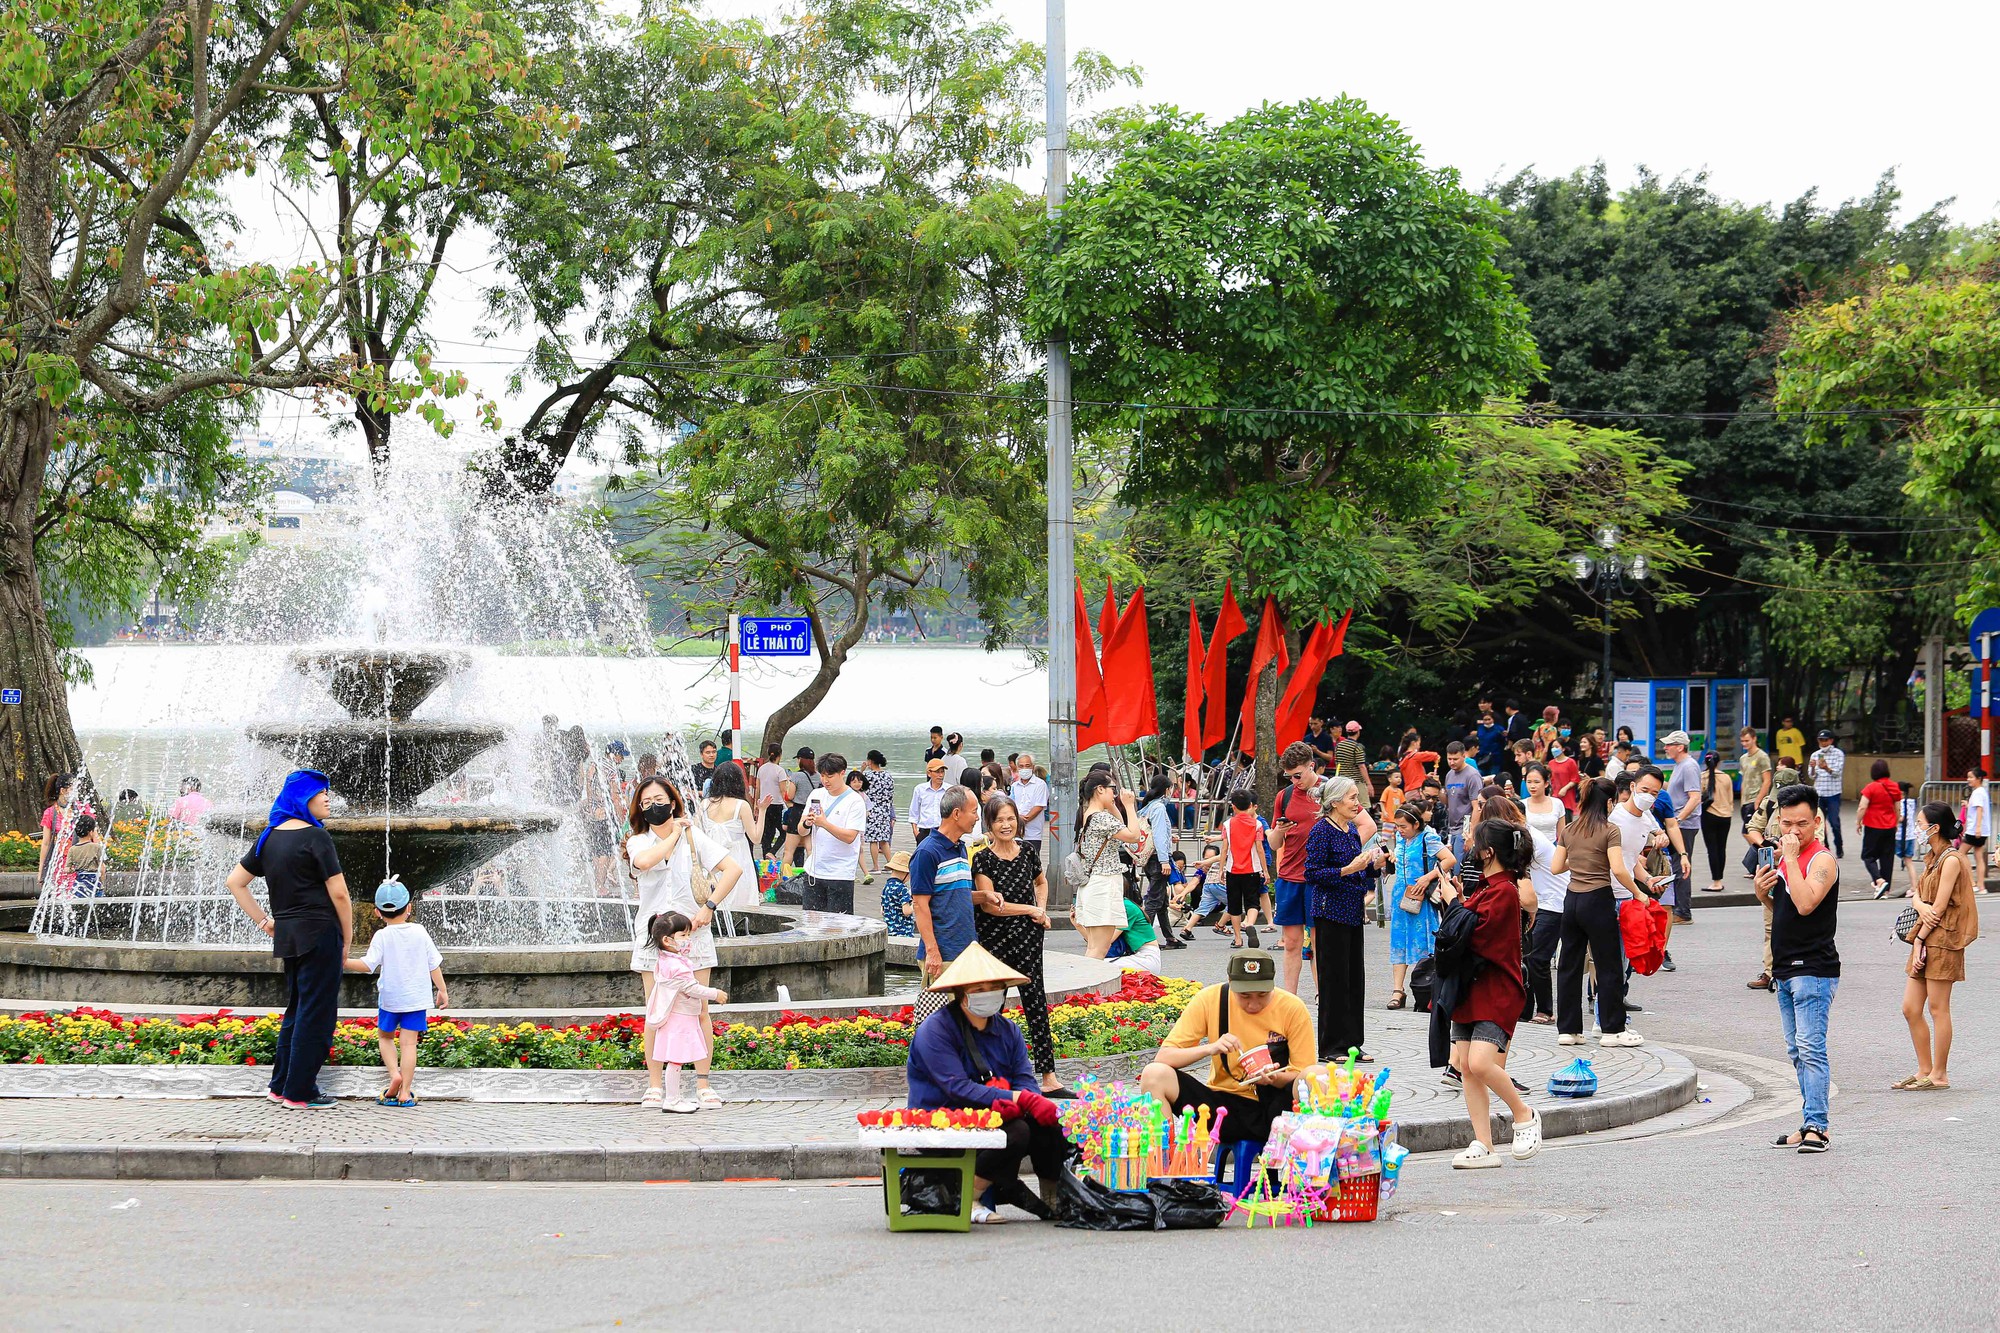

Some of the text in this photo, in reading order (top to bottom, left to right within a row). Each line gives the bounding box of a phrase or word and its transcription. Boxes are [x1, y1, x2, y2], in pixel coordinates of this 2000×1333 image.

[771, 621, 792, 631] PHỐ
[747, 632, 805, 650] LÊ THÁI TỔ
